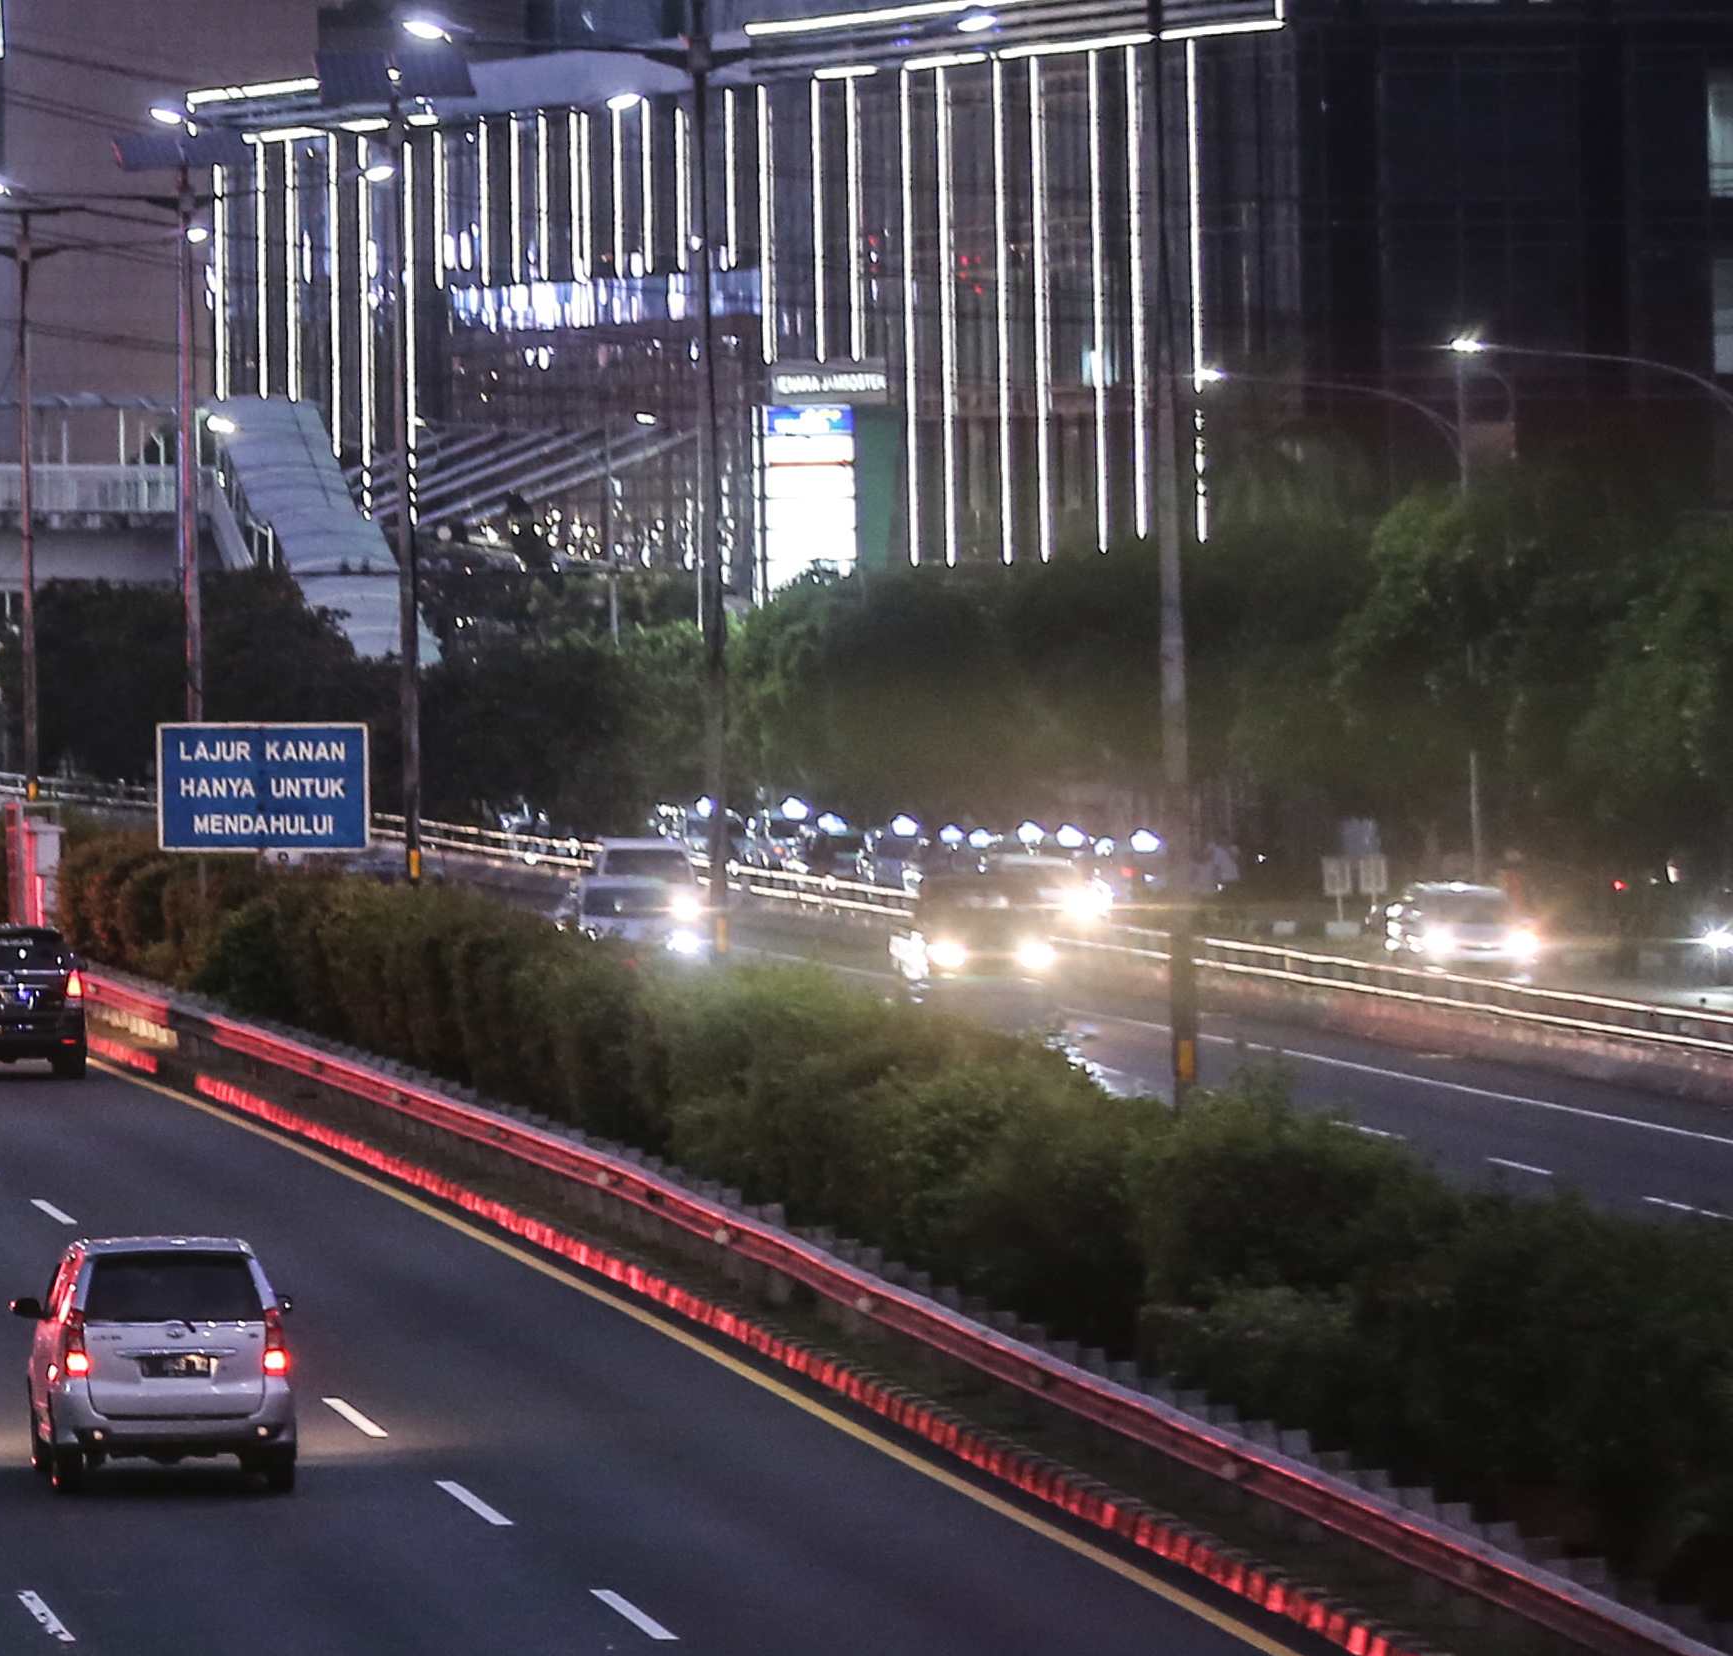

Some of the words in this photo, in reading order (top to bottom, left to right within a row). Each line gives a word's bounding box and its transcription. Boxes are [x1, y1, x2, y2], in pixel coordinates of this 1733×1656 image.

[179, 741, 251, 761] LAJUR
[265, 741, 346, 761] KANAN
[180, 778, 255, 798] HANYA
[271, 778, 345, 798] UNTUK
[193, 814, 334, 835] MENDAHULUI
